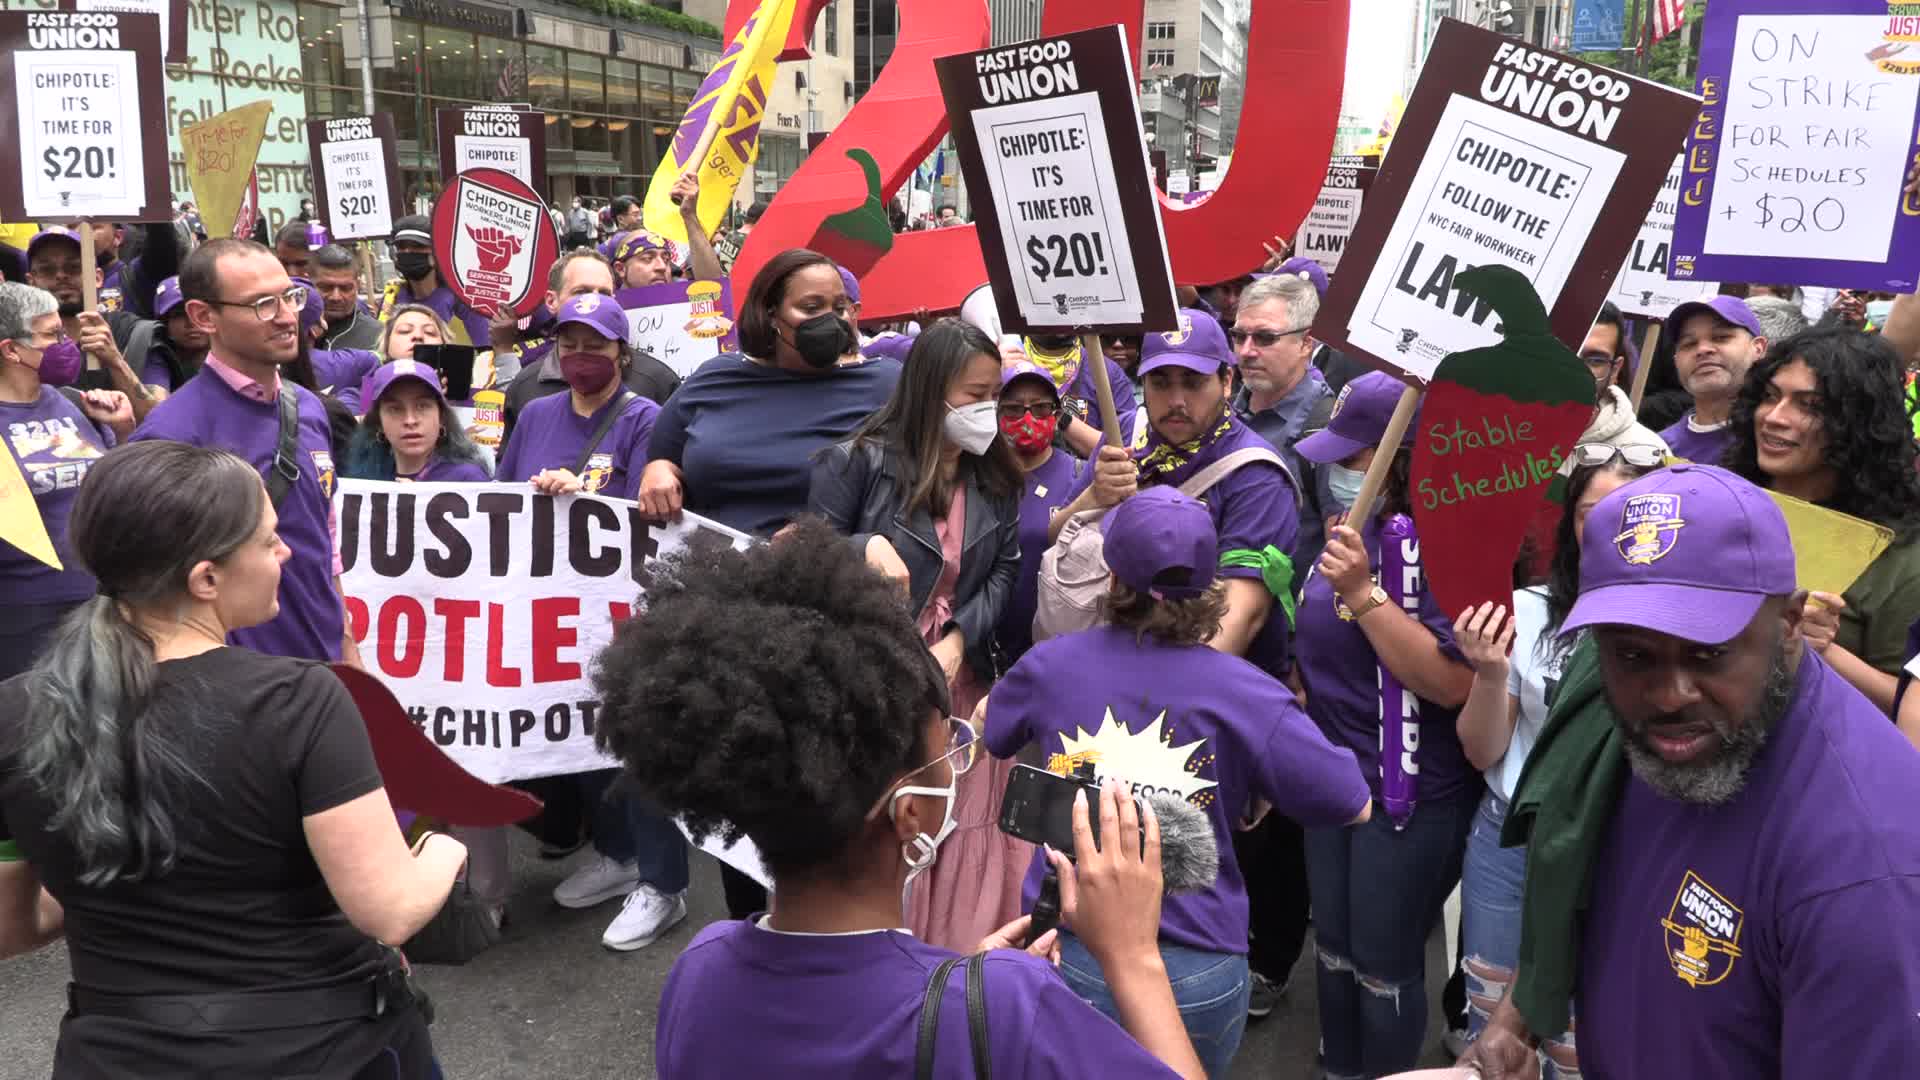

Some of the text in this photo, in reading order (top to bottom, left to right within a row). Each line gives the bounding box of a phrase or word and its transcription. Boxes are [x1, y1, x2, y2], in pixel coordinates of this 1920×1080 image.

[27, 13, 118, 27] FAST FOOD
[28, 28, 120, 49] UNION
[1751, 28, 1820, 62] ON
[975, 40, 1071, 74] FAST FOOD
[1493, 41, 1631, 102] FAST FOOD
[978, 61, 1080, 104] UNION
[1747, 74, 1891, 112] STRIKE
[61, 96, 90, 111] IT'S
[464, 112, 519, 122] FAST FOOD
[1480, 65, 1622, 142] UNION
[42, 120, 113, 135] TIME FOR
[326, 117, 372, 129] FAST FOOD
[326, 125, 373, 142] UNION
[464, 121, 521, 137] UNION
[1731, 124, 1873, 150] FOR FAIR
[1000, 127, 1086, 159] CHIPOTLE:
[43, 145, 116, 181] $20!
[1031, 164, 1063, 188] IT'S
[1455, 137, 1578, 202] CHIPOTLE:
[1731, 158, 1866, 187] SCHEDULES
[339, 194, 378, 218] $20!
[465, 202, 504, 221] WORKERS
[505, 216, 532, 232] UNION
[466, 189, 533, 222] CHIPOTLE
[1017, 194, 1095, 222] TIME FOR
[1441, 182, 1551, 240] FOLLOW THE
[1753, 192, 1846, 233] $20
[1428, 211, 1537, 267] NYC FAIR WORKWEEK
[1026, 231, 1109, 283] $20!
[1395, 240, 1505, 336] LAW
[637, 312, 664, 334] ON
[1428, 415, 1537, 456] Stable
[1416, 444, 1564, 510] Schedules
[1626, 502, 1674, 518] UNION
[1680, 888, 1735, 938] UNION
